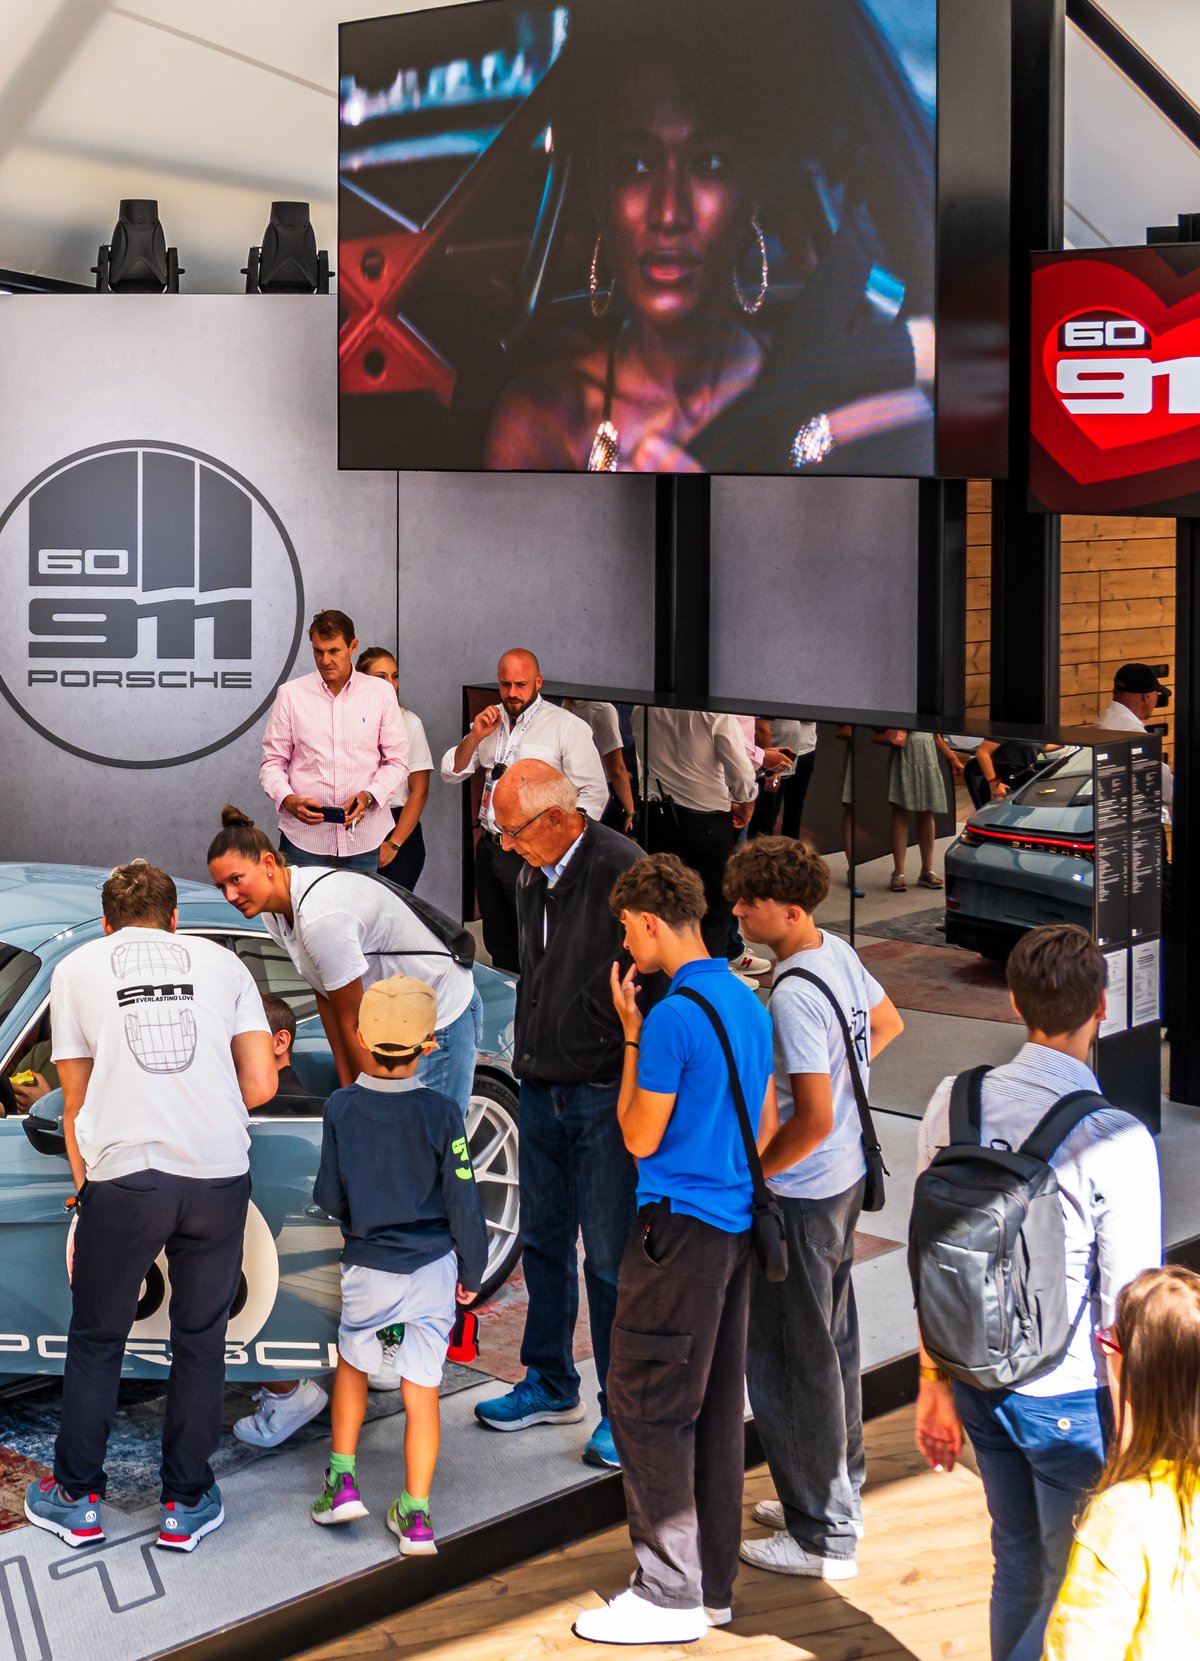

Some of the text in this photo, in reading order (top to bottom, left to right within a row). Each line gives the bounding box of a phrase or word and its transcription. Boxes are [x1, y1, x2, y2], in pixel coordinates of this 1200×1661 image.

[1064, 320, 1146, 347] 60
[1056, 356, 1200, 415] 91
[38, 549, 129, 575] 60
[28, 598, 253, 660] 911
[28, 669, 253, 689] PORSCHE
[116, 984, 193, 1007] 911
